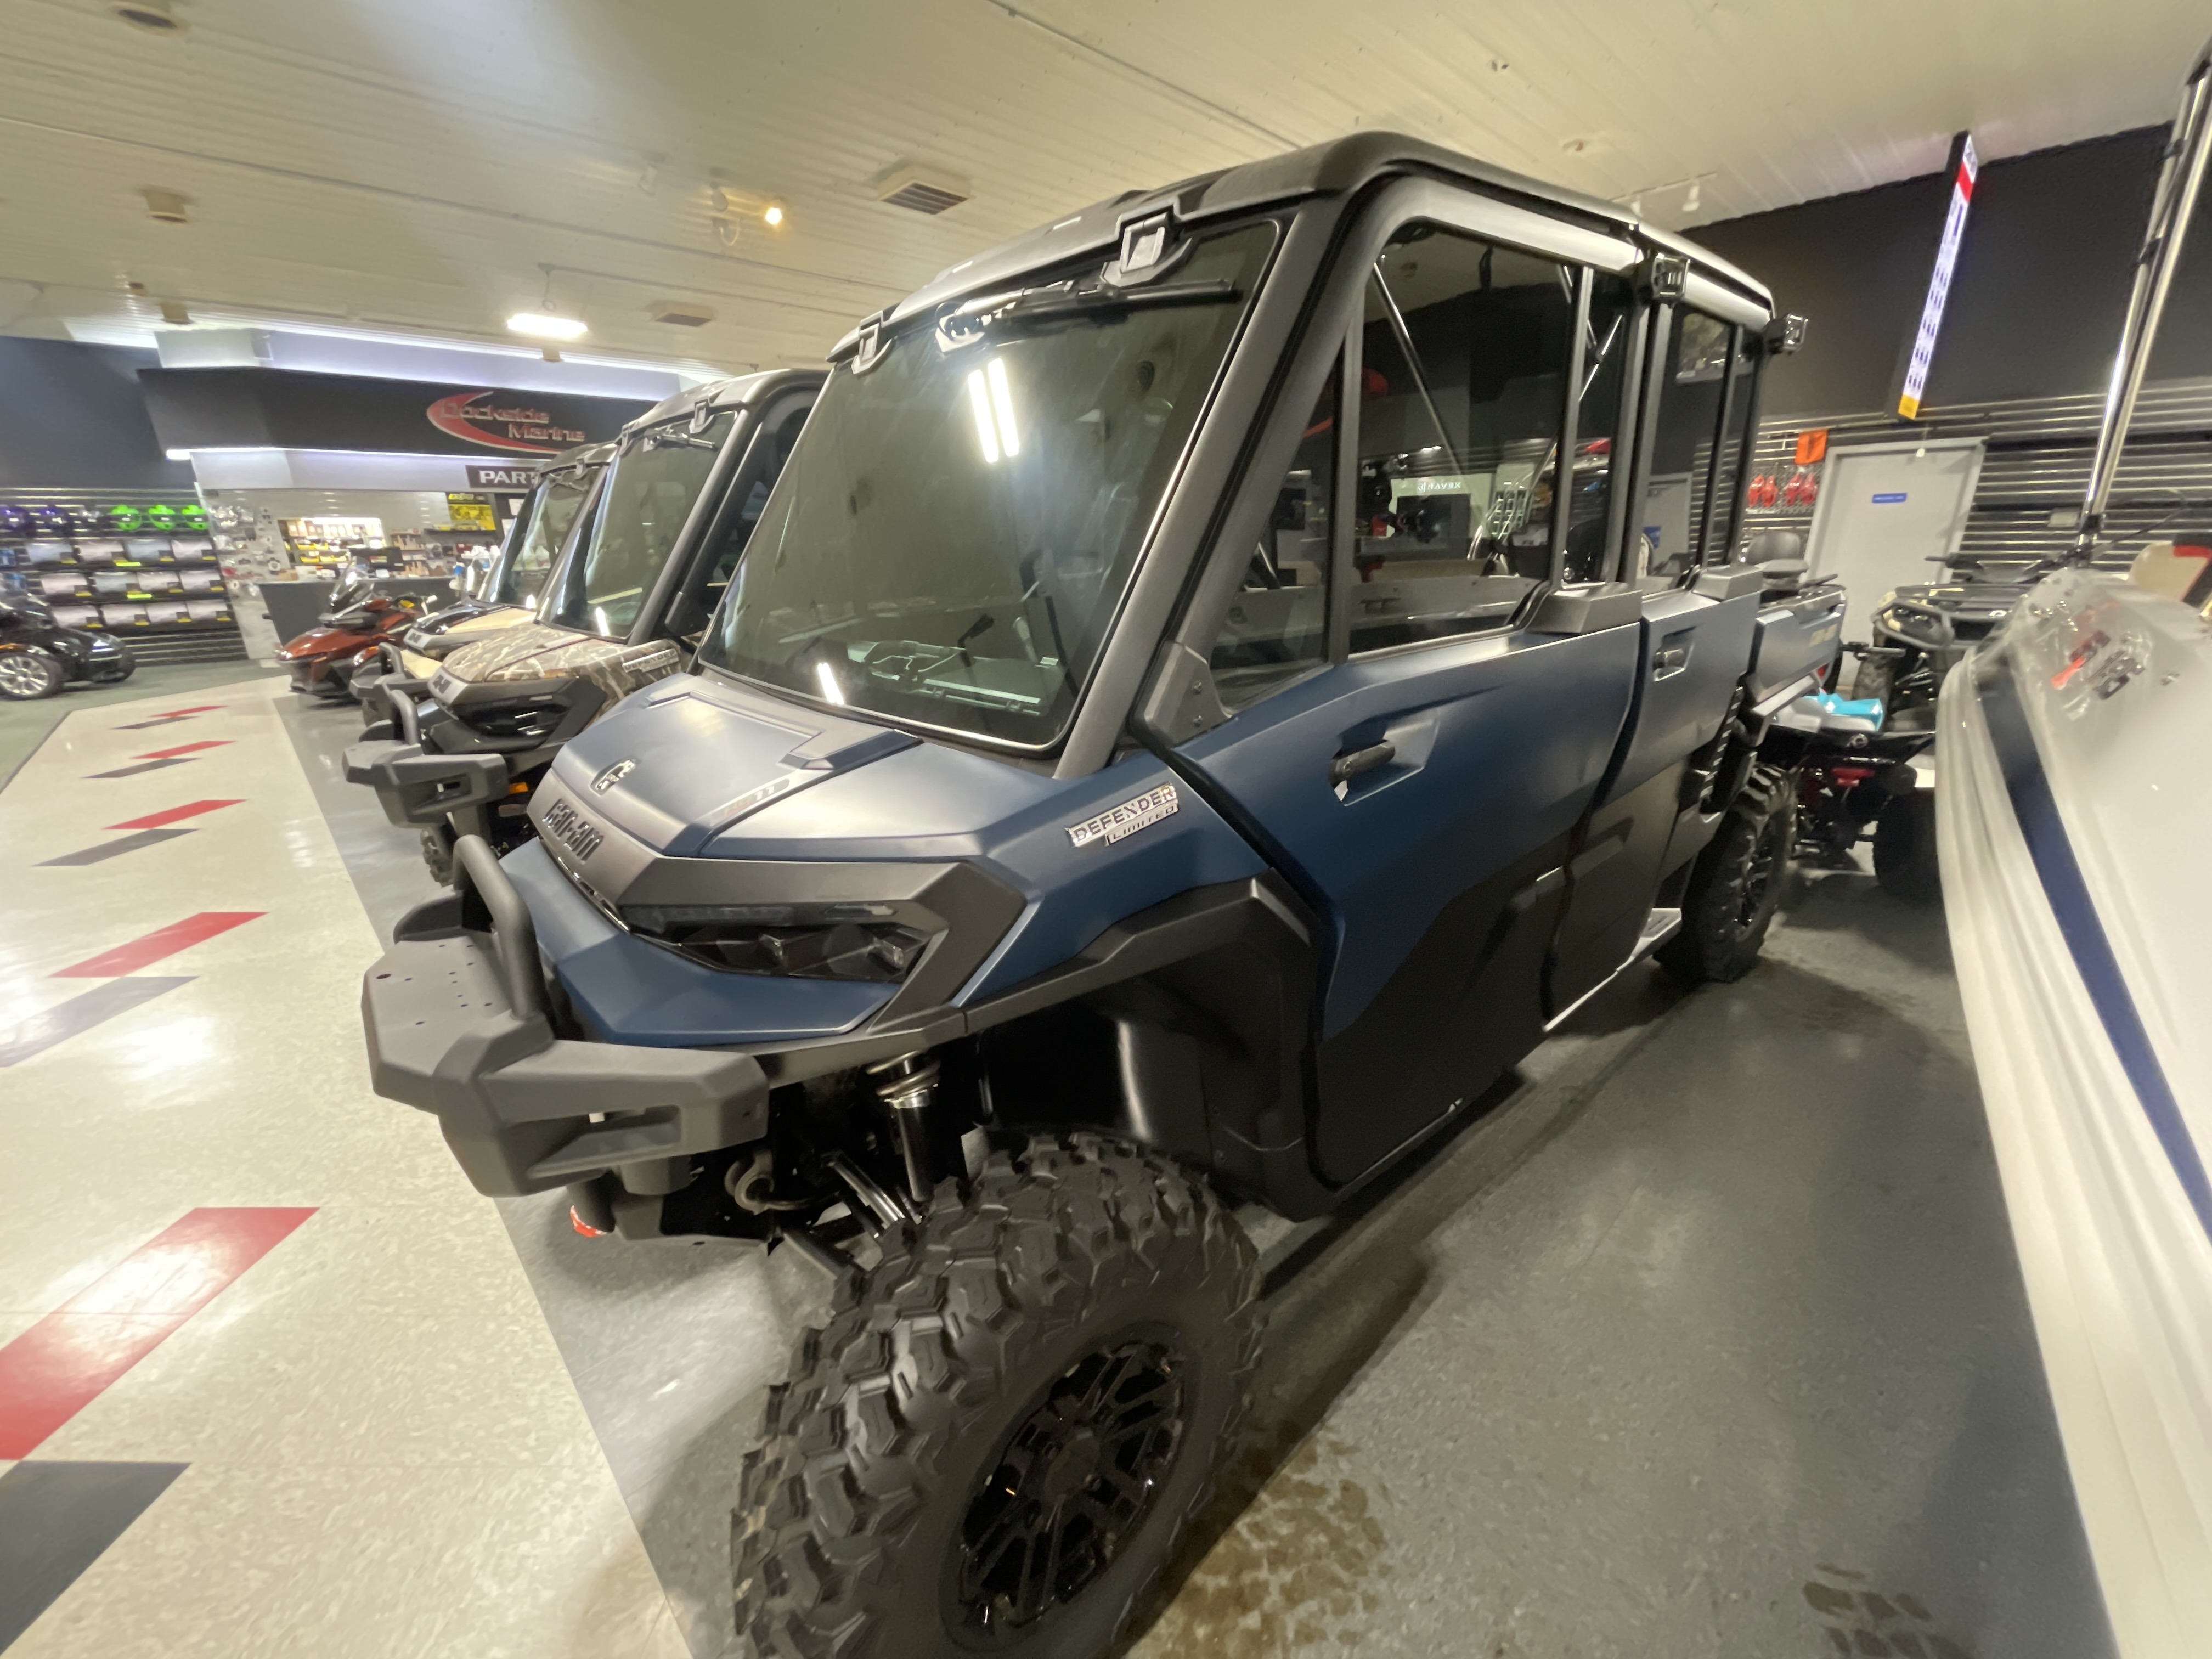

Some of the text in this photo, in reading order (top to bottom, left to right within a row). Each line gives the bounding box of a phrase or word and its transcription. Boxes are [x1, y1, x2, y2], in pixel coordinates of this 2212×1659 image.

[440, 402, 549, 424] Dockside
[508, 422, 585, 442] Marine
[1073, 785, 1175, 843] DEFENDER
